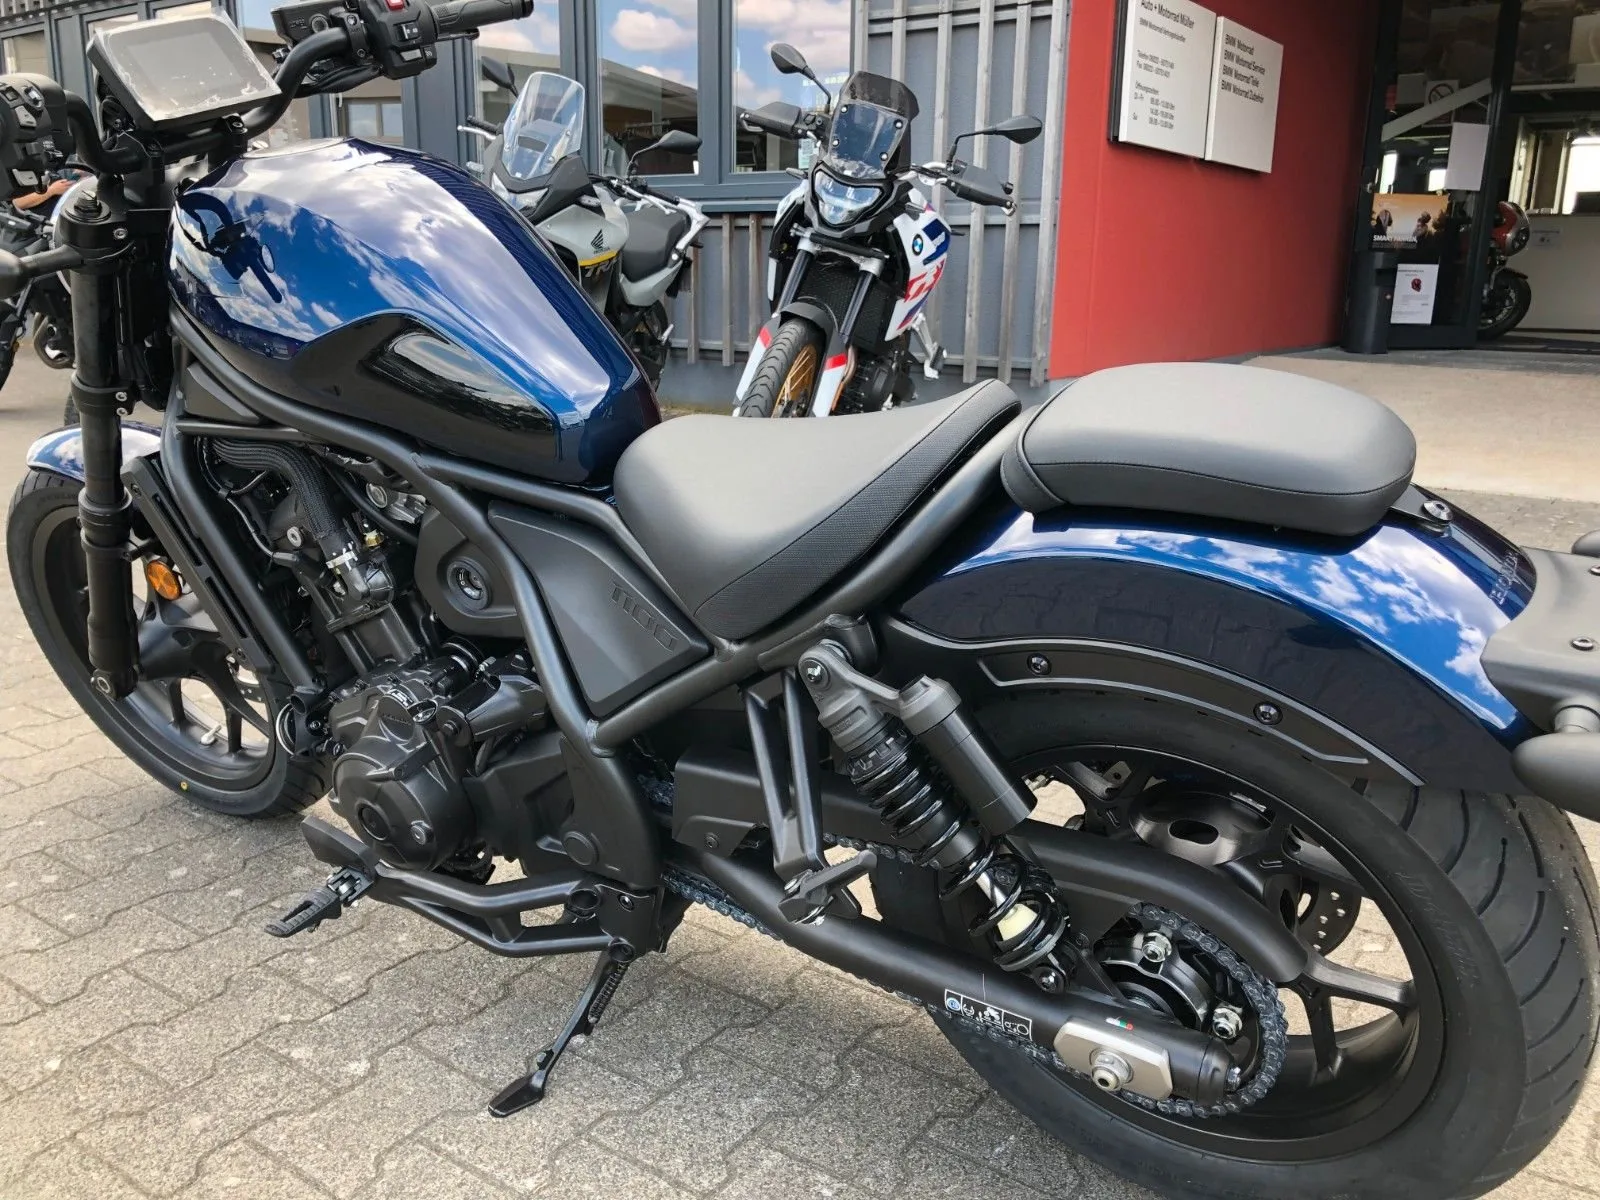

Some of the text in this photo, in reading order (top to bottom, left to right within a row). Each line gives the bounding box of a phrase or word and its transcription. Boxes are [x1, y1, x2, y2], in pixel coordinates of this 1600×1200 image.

[1158, 3, 1179, 23] Motorrad
[1225, 33, 1236, 47] BMW
[1224, 49, 1235, 62] BMW
[1222, 64, 1233, 77] BMW
[1221, 79, 1232, 92] BMW
